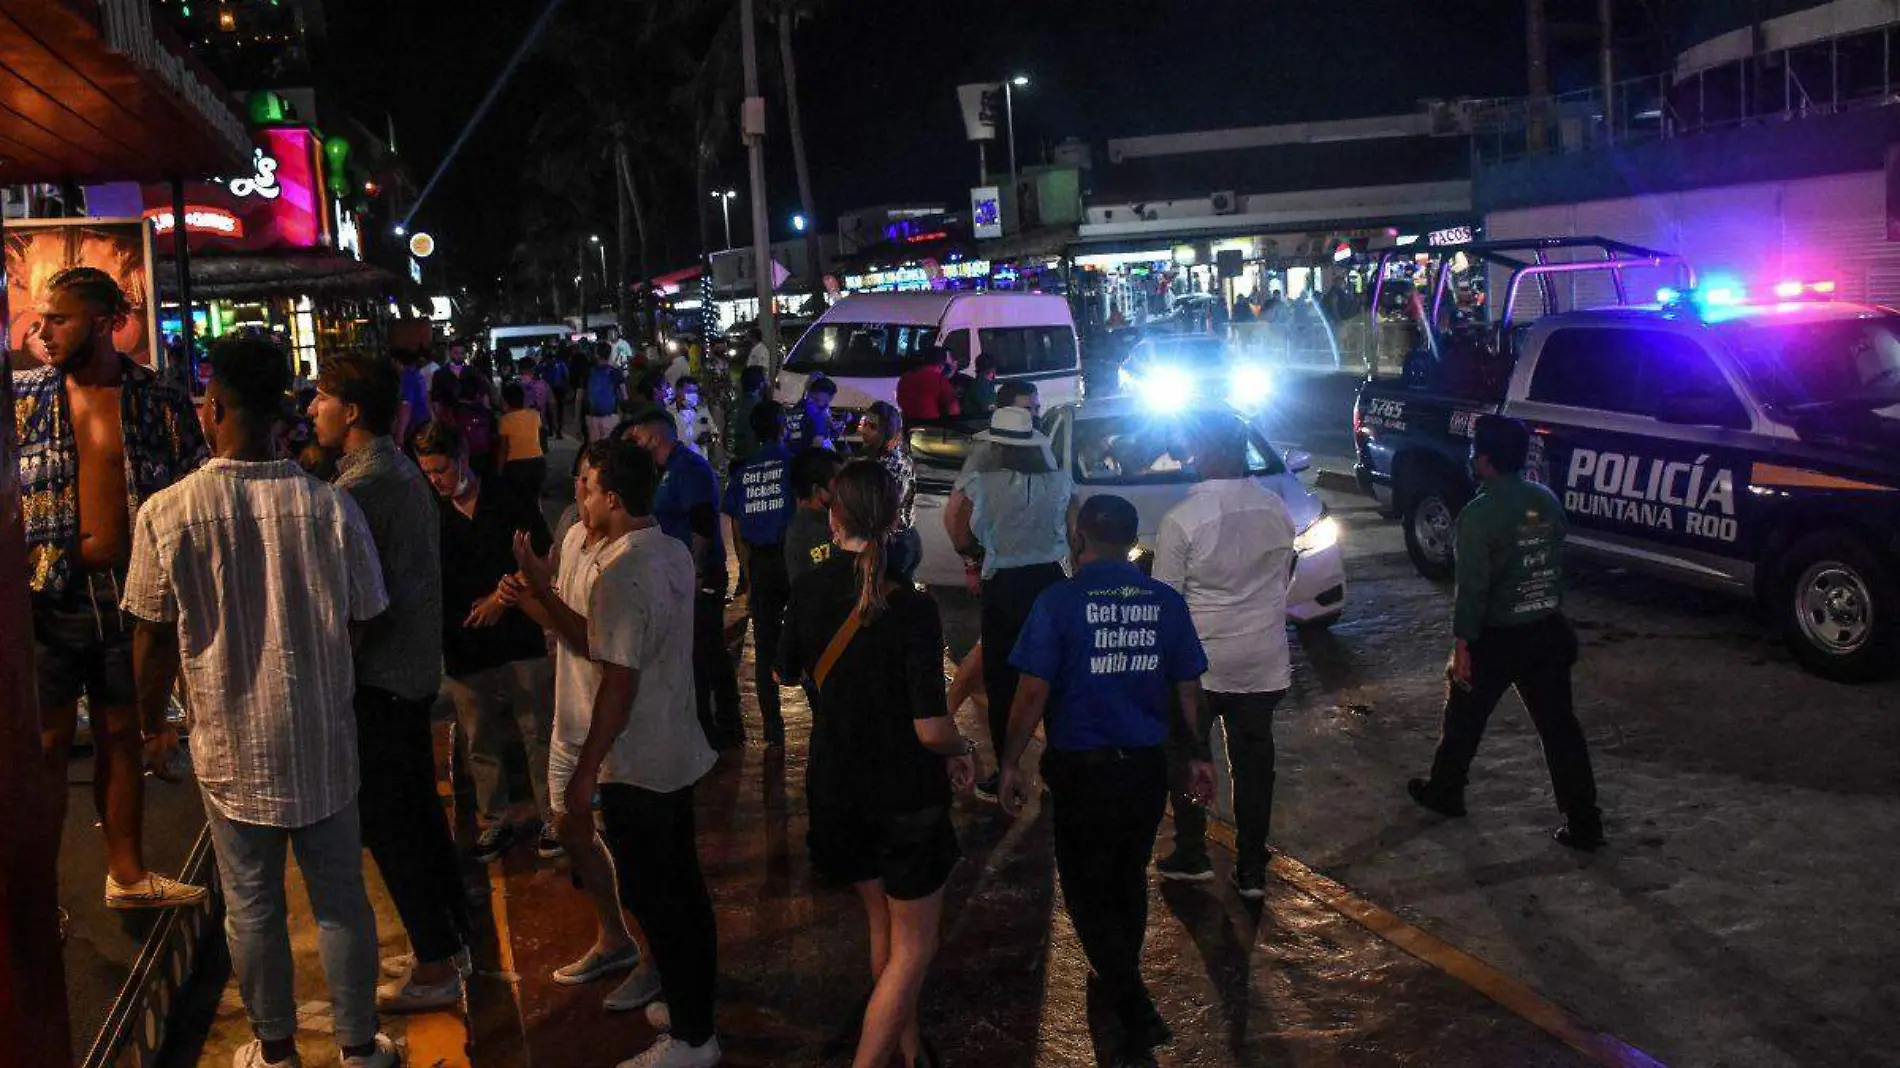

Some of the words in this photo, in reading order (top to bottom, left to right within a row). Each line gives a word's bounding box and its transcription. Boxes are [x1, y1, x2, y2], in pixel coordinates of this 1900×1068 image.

[1429, 228, 1471, 243] TACOS
[1567, 447, 1735, 515] POLICÍA
[1564, 489, 1674, 530] QUINTANA
[1685, 511, 1738, 543] ROO
[1086, 602, 1118, 624] Get
[1120, 603, 1160, 624] your
[1094, 626, 1157, 649] tickets
[1090, 651, 1128, 674] with
[1130, 654, 1159, 672] me
